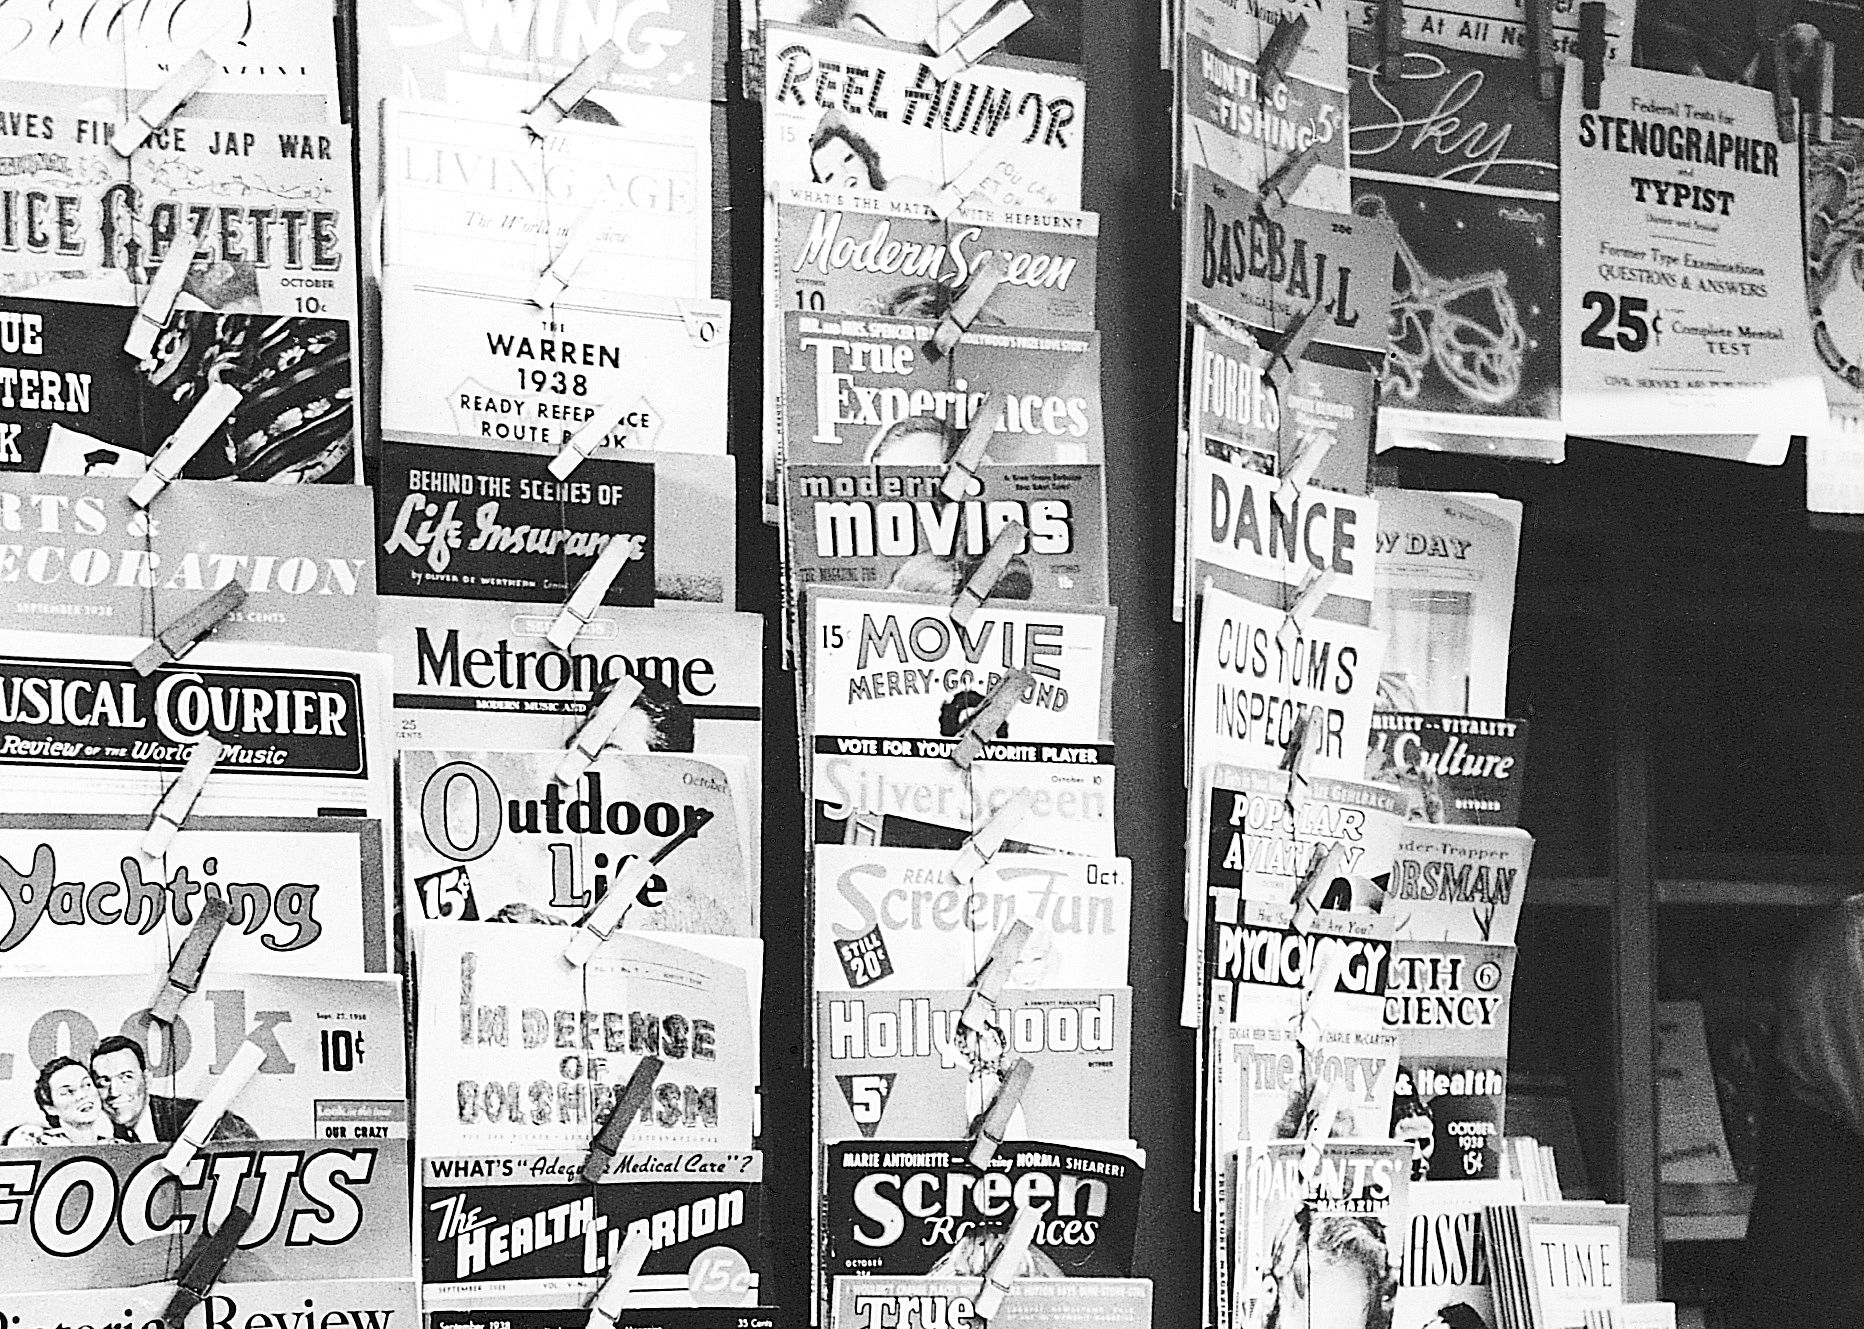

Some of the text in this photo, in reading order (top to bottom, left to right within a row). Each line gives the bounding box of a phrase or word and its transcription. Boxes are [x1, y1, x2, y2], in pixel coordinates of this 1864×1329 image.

[1421, 17, 1487, 41] At All
[775, 44, 888, 120] REEL
[1631, 96, 1679, 117] Federal
[1219, 90, 1318, 150] FISHING
[209, 132, 331, 159] JAP WAR
[1579, 113, 1779, 178] STENOGRAPHER
[1630, 176, 1735, 216] TYPIST
[101, 183, 343, 277] GAZETTE
[793, 210, 947, 280] Modern
[281, 278, 334, 289] OCTOBER
[1202, 203, 1359, 328] BASEBALL
[1581, 291, 1663, 352] 25¢
[487, 332, 619, 368] WARREN
[1706, 341, 1751, 356] TEST
[461, 394, 524, 416] READY
[518, 368, 587, 396] 1938
[799, 337, 915, 445] True
[1205, 351, 1280, 433] FORBES
[482, 421, 549, 443] ROUTE
[410, 469, 623, 506] BEHIND THE SCENES OF
[814, 500, 1074, 558] movies
[1211, 473, 1358, 575] DANCE
[1406, 532, 1472, 560] DAY
[415, 627, 717, 696] Metronome
[857, 614, 1064, 680] MOVIE
[1217, 618, 1358, 695] CUSTOMS
[156, 672, 347, 743] COURIER
[1442, 718, 1517, 737] VITALITY
[3, 735, 84, 758] Review
[838, 738, 1098, 763] VOTE FOR PLAYER
[1393, 731, 1515, 778] Culture
[421, 760, 713, 861] Outdoor
[824, 758, 956, 820] Silver
[0, 843, 322, 951] Yachting
[1087, 863, 1125, 886] Oct.
[831, 863, 1015, 941] Screen
[842, 934, 881, 960] STILL
[522, 1008, 716, 1060] DEFENSE
[1417, 1068, 1503, 1097] Health
[325, 1125, 388, 1138] OUR CRAZY
[431, 1153, 678, 1178] WHAT'S Medical
[843, 1153, 949, 1167] MARIE ANTOINETTE
[0, 1148, 378, 1257] FOCUS
[853, 1171, 1109, 1247] Screen
[430, 1194, 594, 1279] The HEALTH
[1541, 1241, 1613, 1288] TIME
